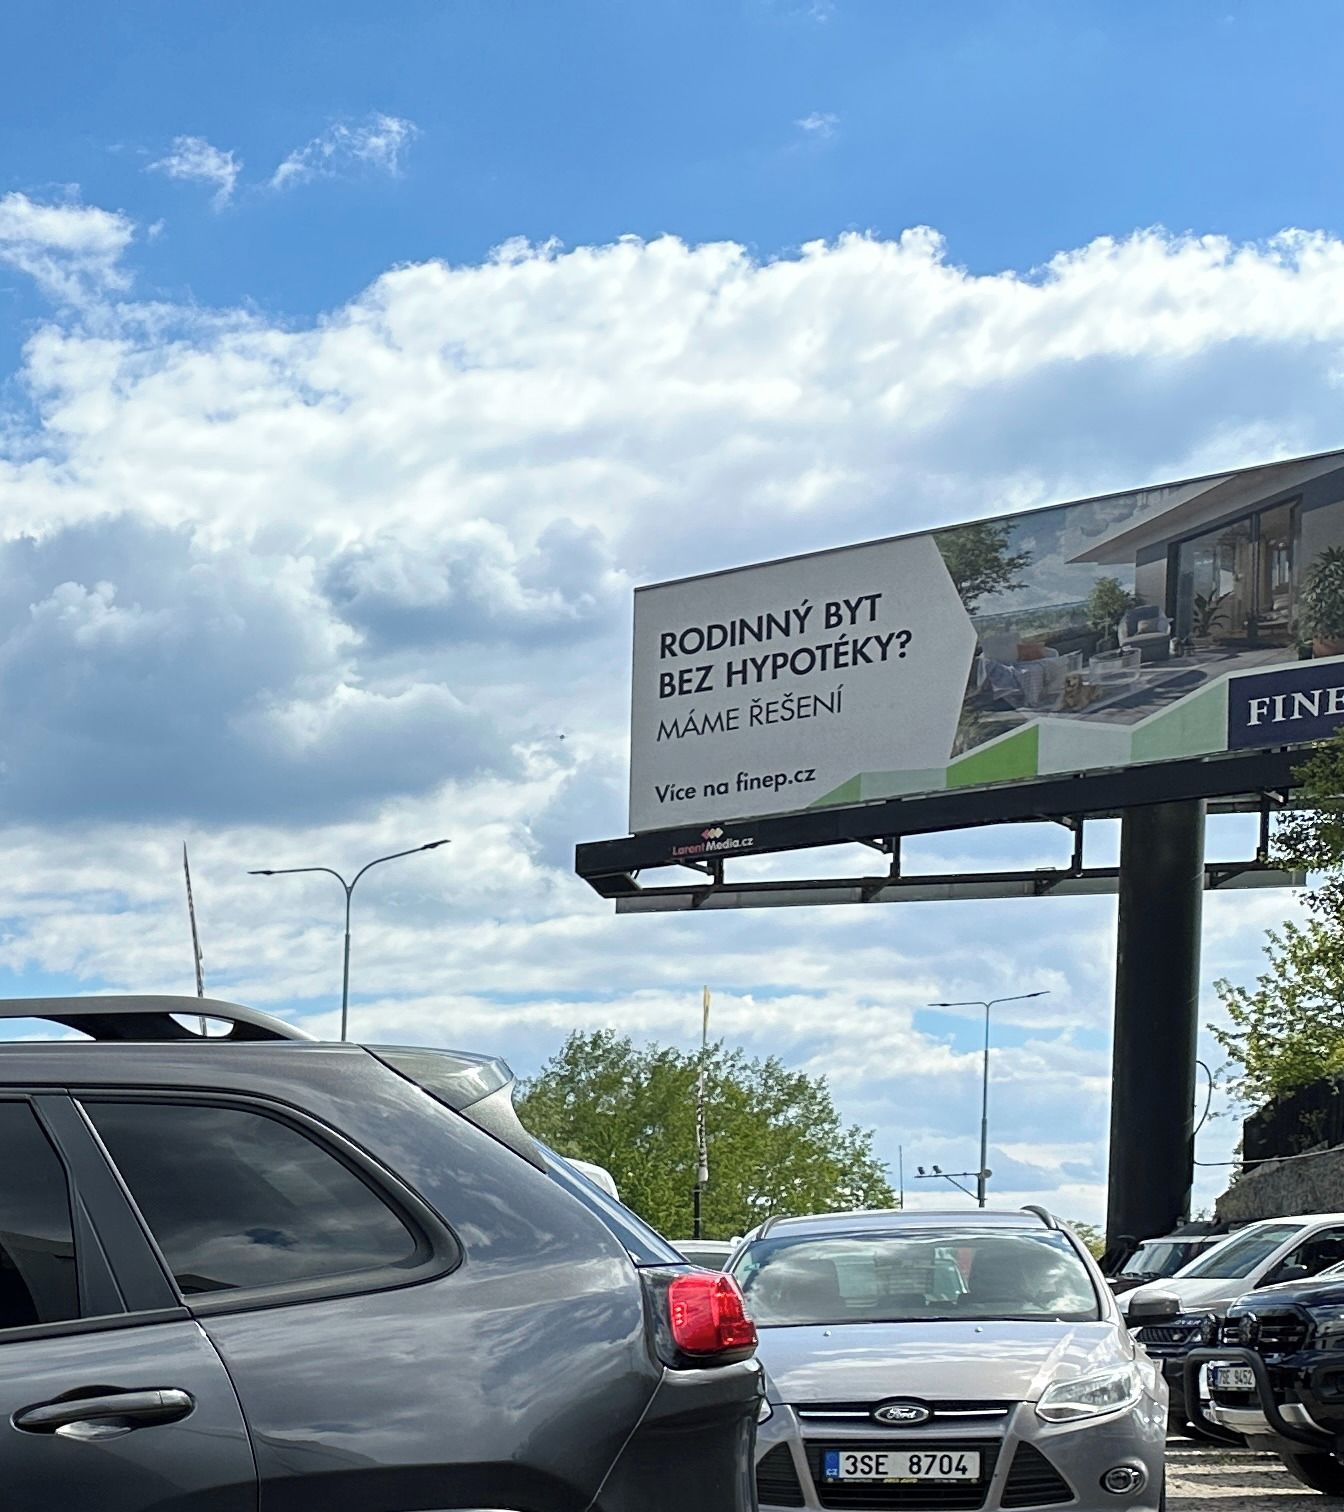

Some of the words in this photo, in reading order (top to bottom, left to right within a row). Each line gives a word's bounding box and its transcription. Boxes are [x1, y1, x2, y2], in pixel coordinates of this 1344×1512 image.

[660, 599, 814, 659] RODINNÝ
[824, 593, 883, 630] BYT
[659, 665, 714, 699] BEZ
[726, 630, 913, 688] HYPOTÉKY?
[656, 707, 740, 742] MÁME
[749, 684, 845, 728] ŘEŠENÍ
[655, 783, 697, 803] Více
[703, 780, 729, 797] na
[736, 768, 816, 793] finep.cz
[886, 1407, 916, 1419] Ford
[844, 1454, 889, 1475] 3SE
[909, 1454, 968, 1475] 8704
